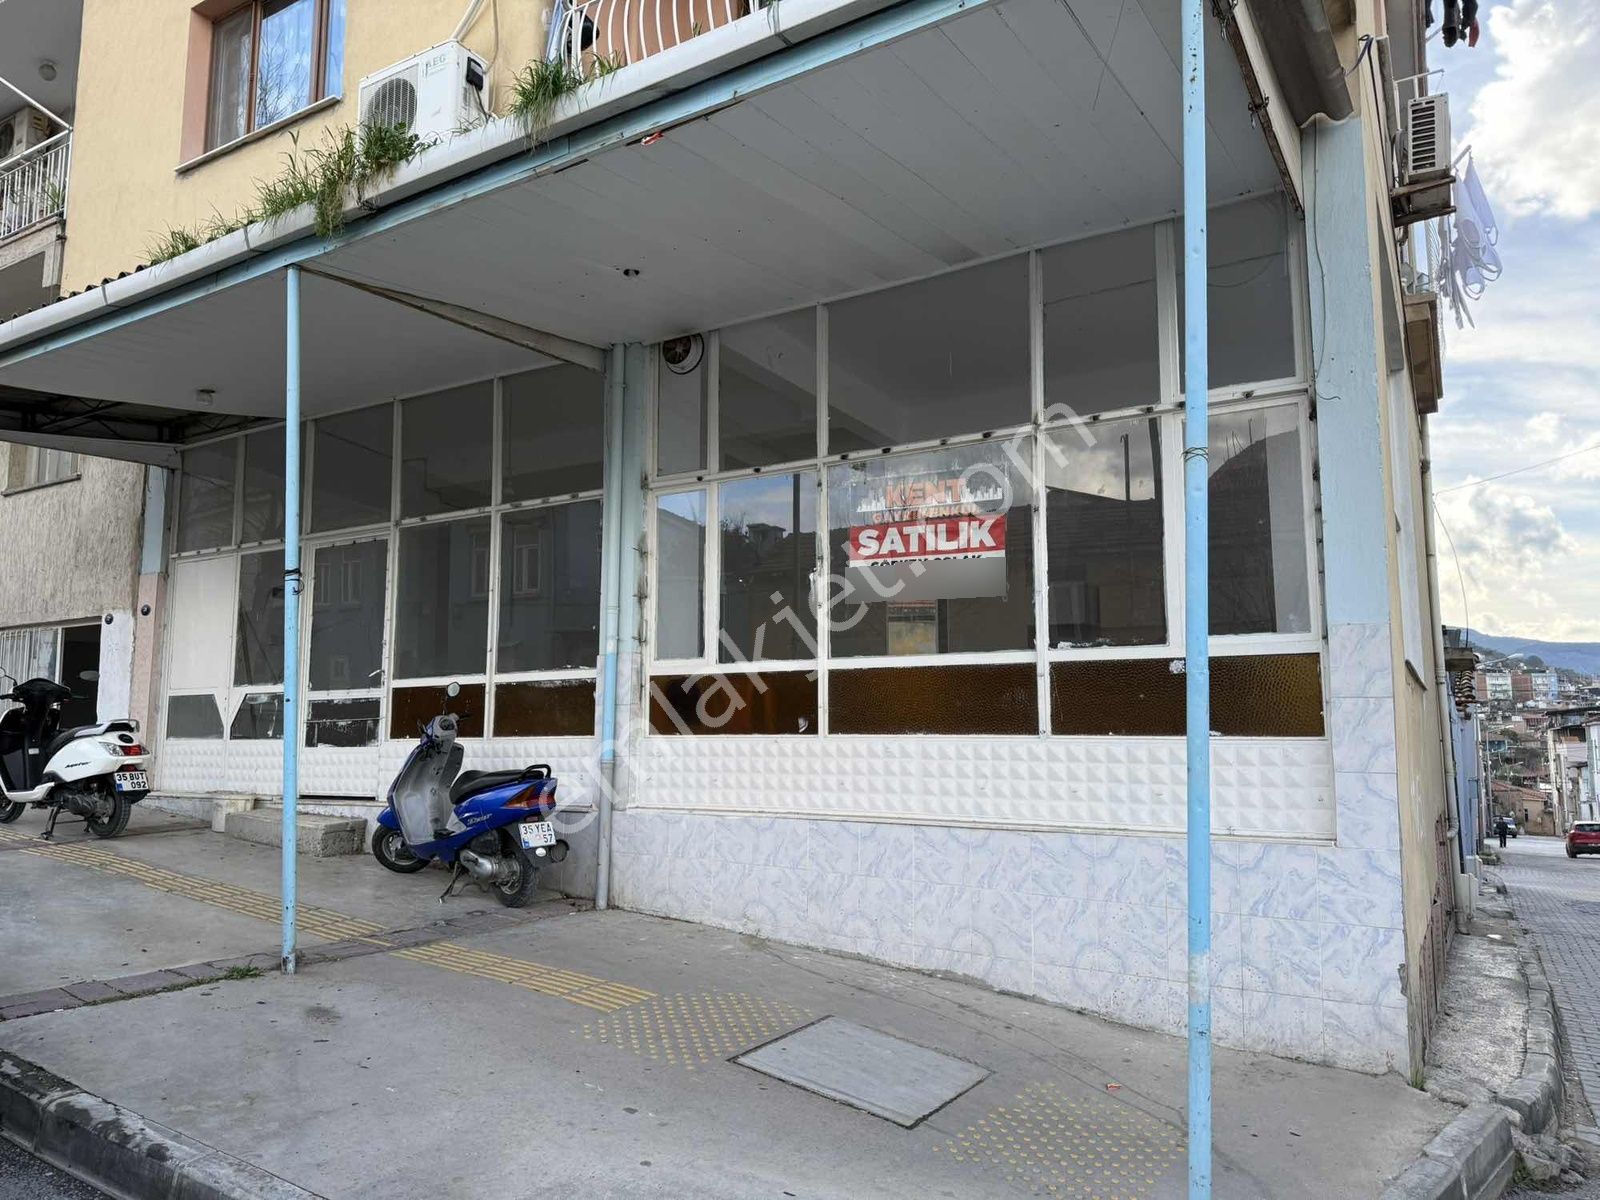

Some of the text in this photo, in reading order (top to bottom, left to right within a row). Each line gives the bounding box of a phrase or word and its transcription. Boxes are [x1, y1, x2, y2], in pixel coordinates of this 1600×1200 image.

[885, 478, 962, 507] KENT
[858, 520, 996, 556] SATILIK
[116, 772, 145, 781] 35 BUT
[130, 781, 147, 789] 092
[522, 823, 553, 835] 35 YEA
[543, 833, 553, 843] 57
